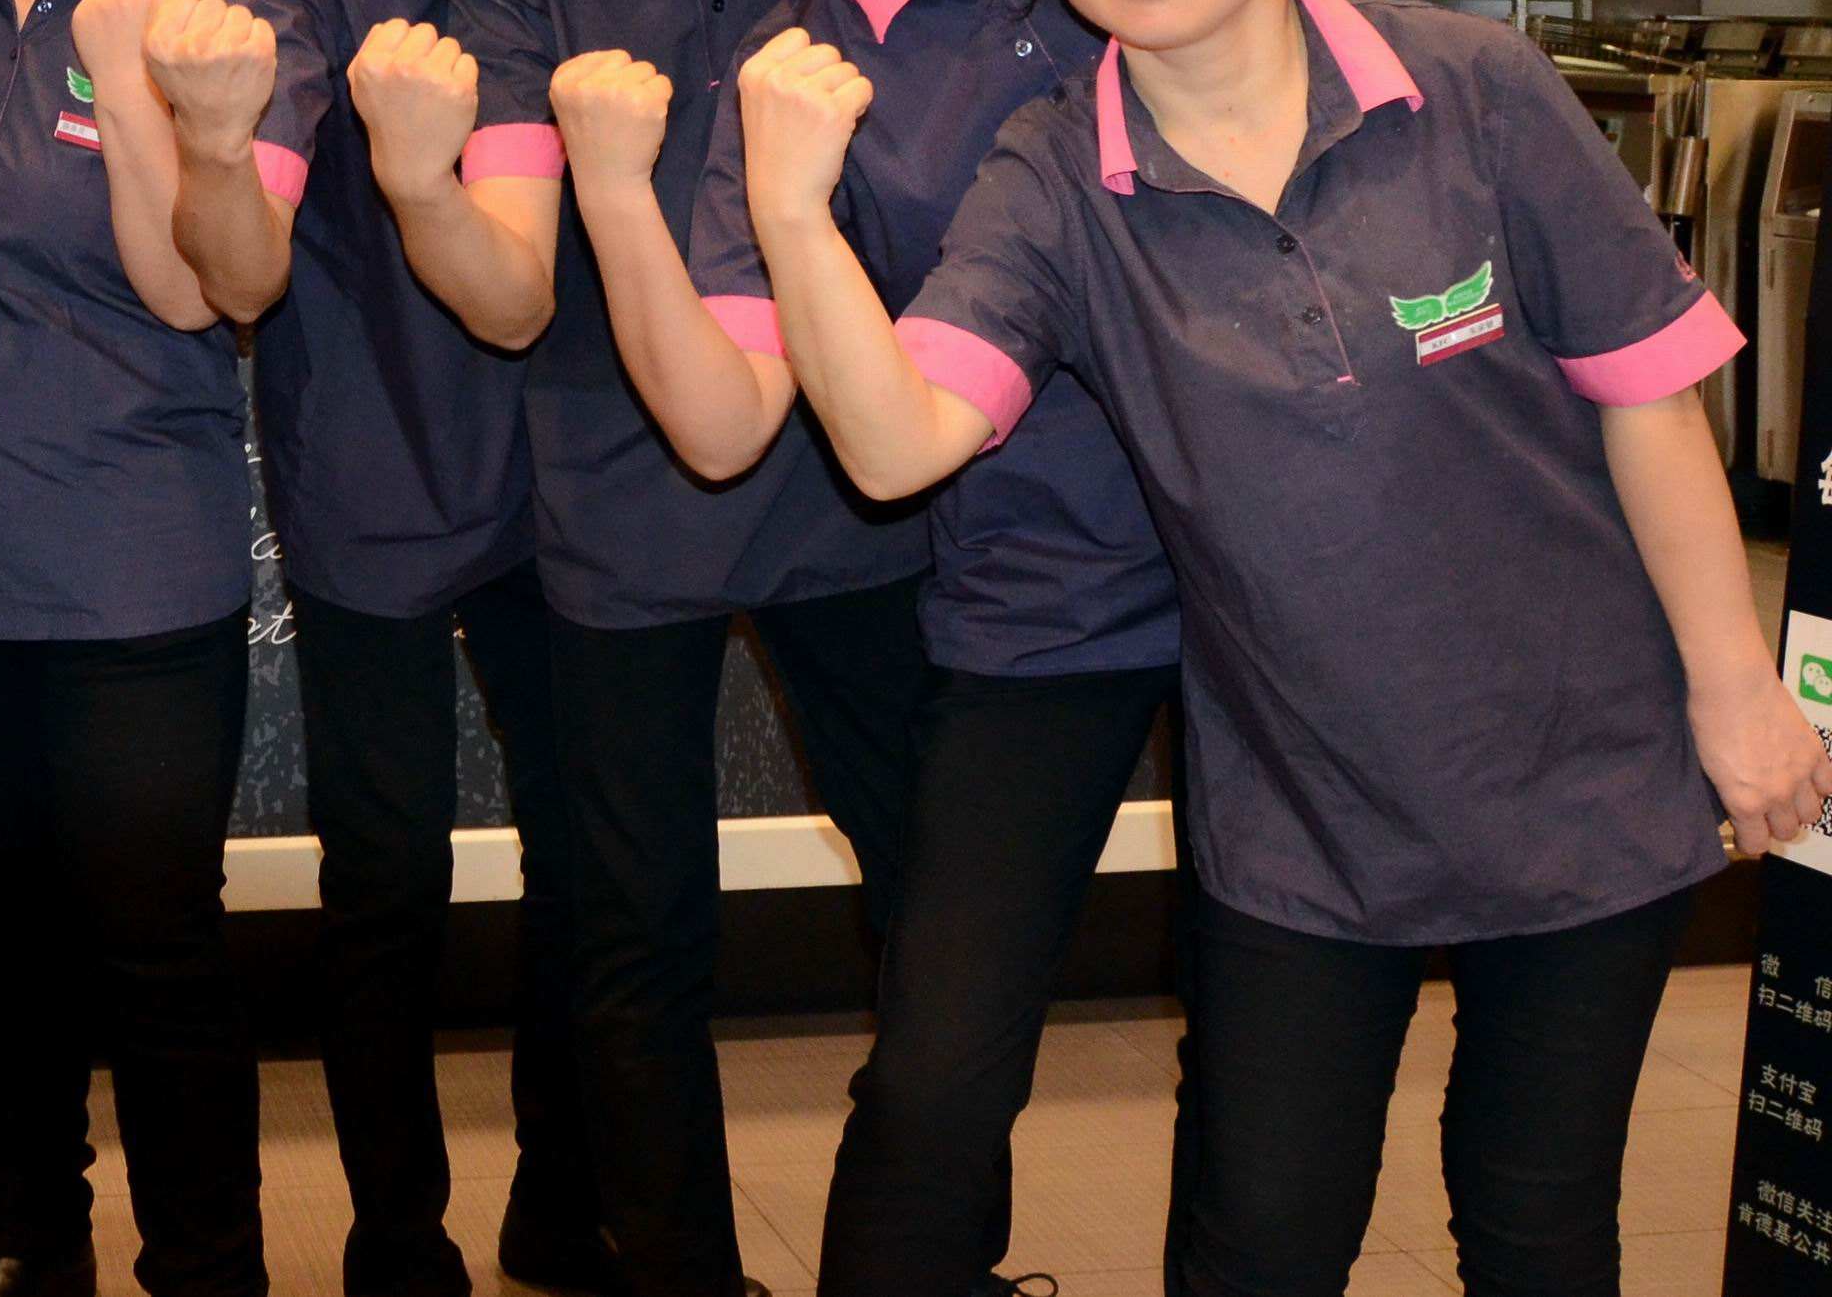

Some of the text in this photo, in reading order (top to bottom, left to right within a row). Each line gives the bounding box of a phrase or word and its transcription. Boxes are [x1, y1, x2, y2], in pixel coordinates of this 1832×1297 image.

[1760, 953, 1781, 978] 微
[1757, 983, 1832, 1034] 扫二维码
[1760, 1063, 1817, 1105] 支付宝
[1747, 1088, 1823, 1142] 扫二维码
[1757, 1179, 1832, 1235] 微信关注
[1737, 1202, 1832, 1265] 肯德基公共
